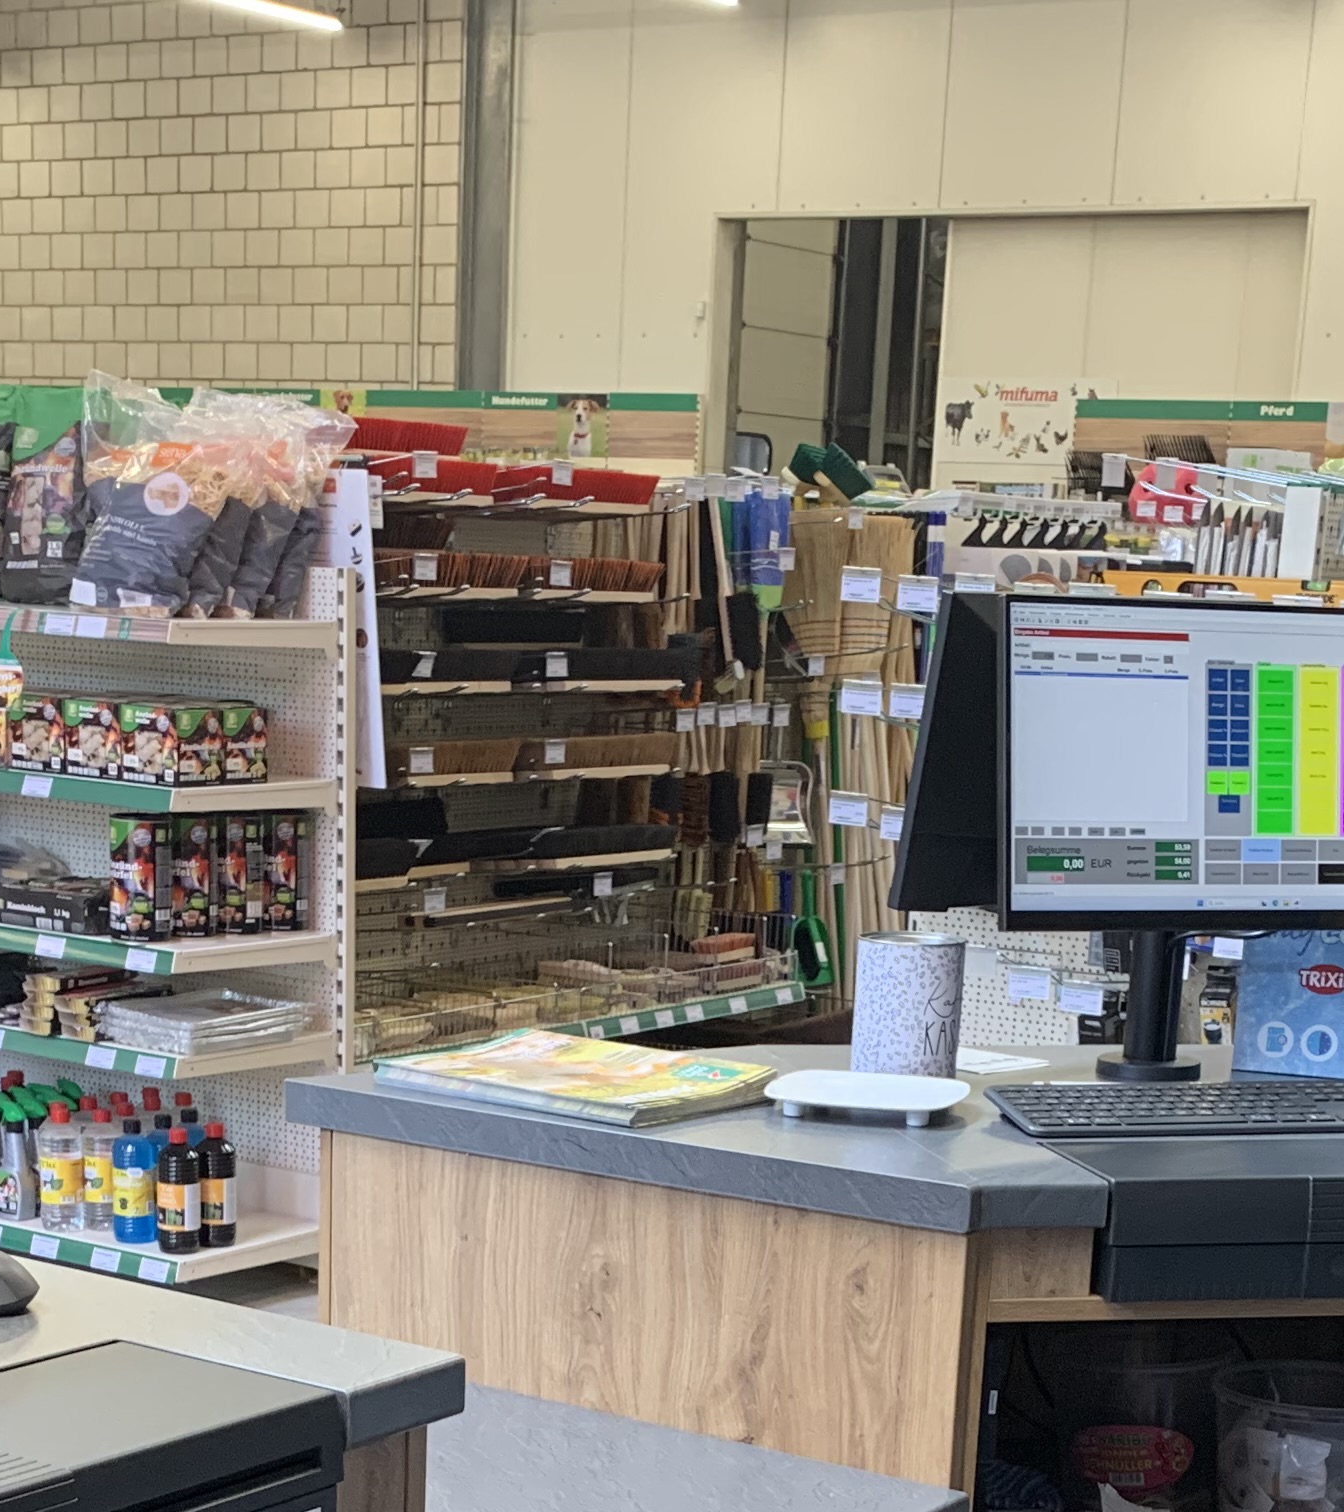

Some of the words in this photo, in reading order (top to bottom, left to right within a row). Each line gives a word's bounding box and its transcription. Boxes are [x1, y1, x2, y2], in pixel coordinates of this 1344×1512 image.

[491, 395, 549, 407] Hundefutter
[1000, 386, 1058, 403] mifuma
[1259, 404, 1294, 417] Pferd
[1026, 844, 1081, 856] Belegsumme
[1062, 857, 1084, 870] 0,00
[1090, 857, 1112, 869] EUR
